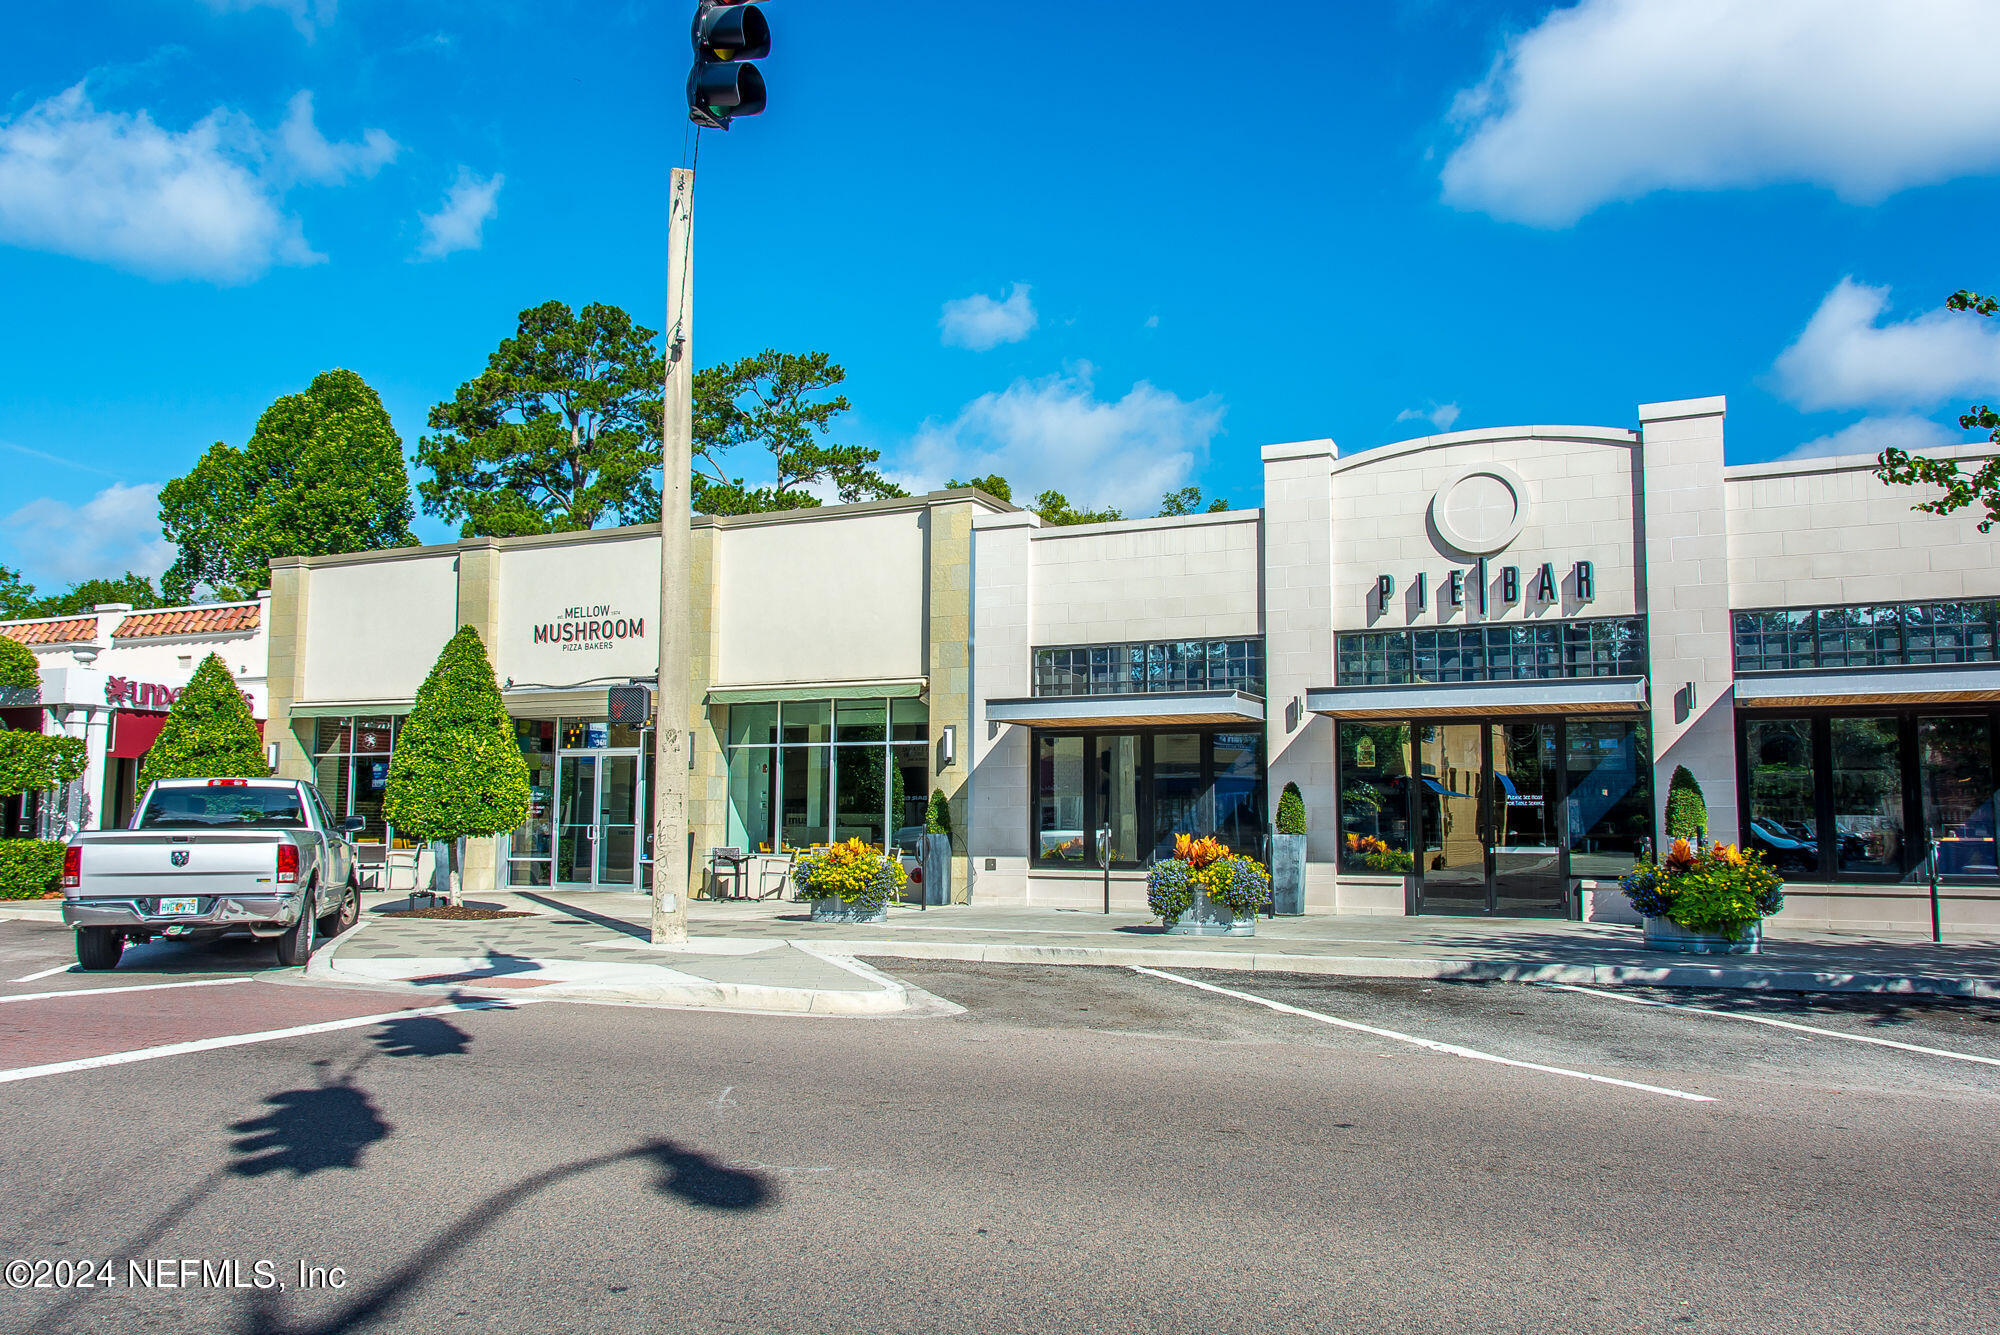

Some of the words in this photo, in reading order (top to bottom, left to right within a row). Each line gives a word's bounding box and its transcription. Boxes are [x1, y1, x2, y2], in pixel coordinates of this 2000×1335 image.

[1378, 569, 1464, 615] PIE
[1503, 561, 1595, 605] BAR
[564, 605, 610, 619] MELLOW
[534, 618, 645, 644] MUSHROOM
[562, 643, 582, 651] PIZZA
[584, 641, 613, 650] BAKERS
